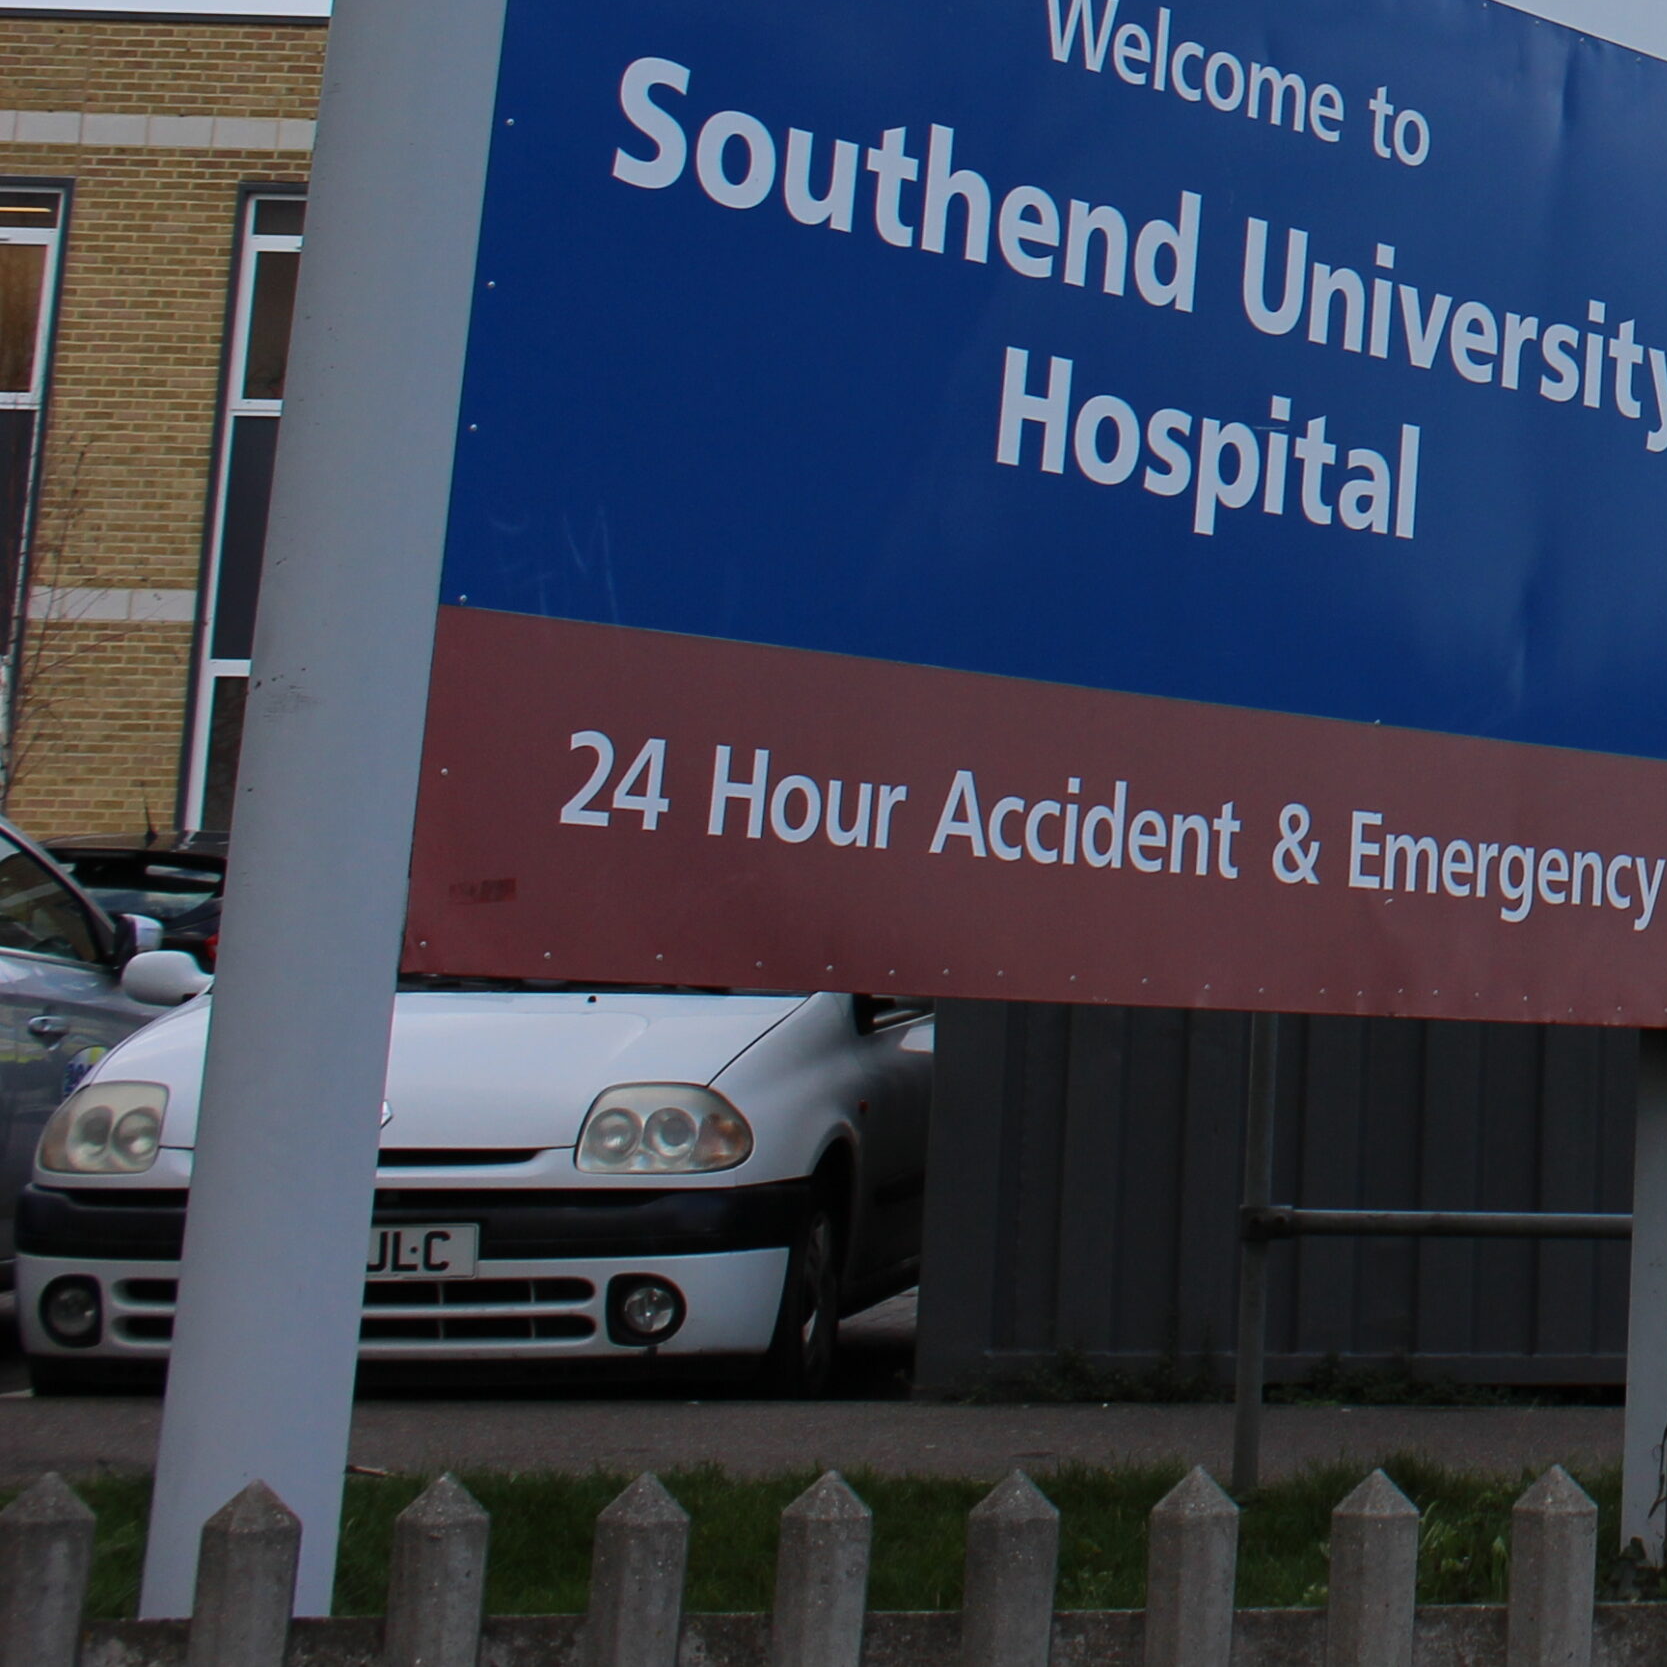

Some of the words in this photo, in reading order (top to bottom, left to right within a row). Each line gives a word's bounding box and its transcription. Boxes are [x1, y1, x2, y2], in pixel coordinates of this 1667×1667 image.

[612, 56, 1201, 314] Southend
[1368, 85, 1431, 168] to
[996, 345, 1420, 540] Hospital
[560, 729, 670, 832] 24
[706, 744, 908, 850] Hour
[929, 768, 1242, 880] Accident
[1272, 803, 1321, 886] &
[1347, 810, 1667, 932] Emergency
